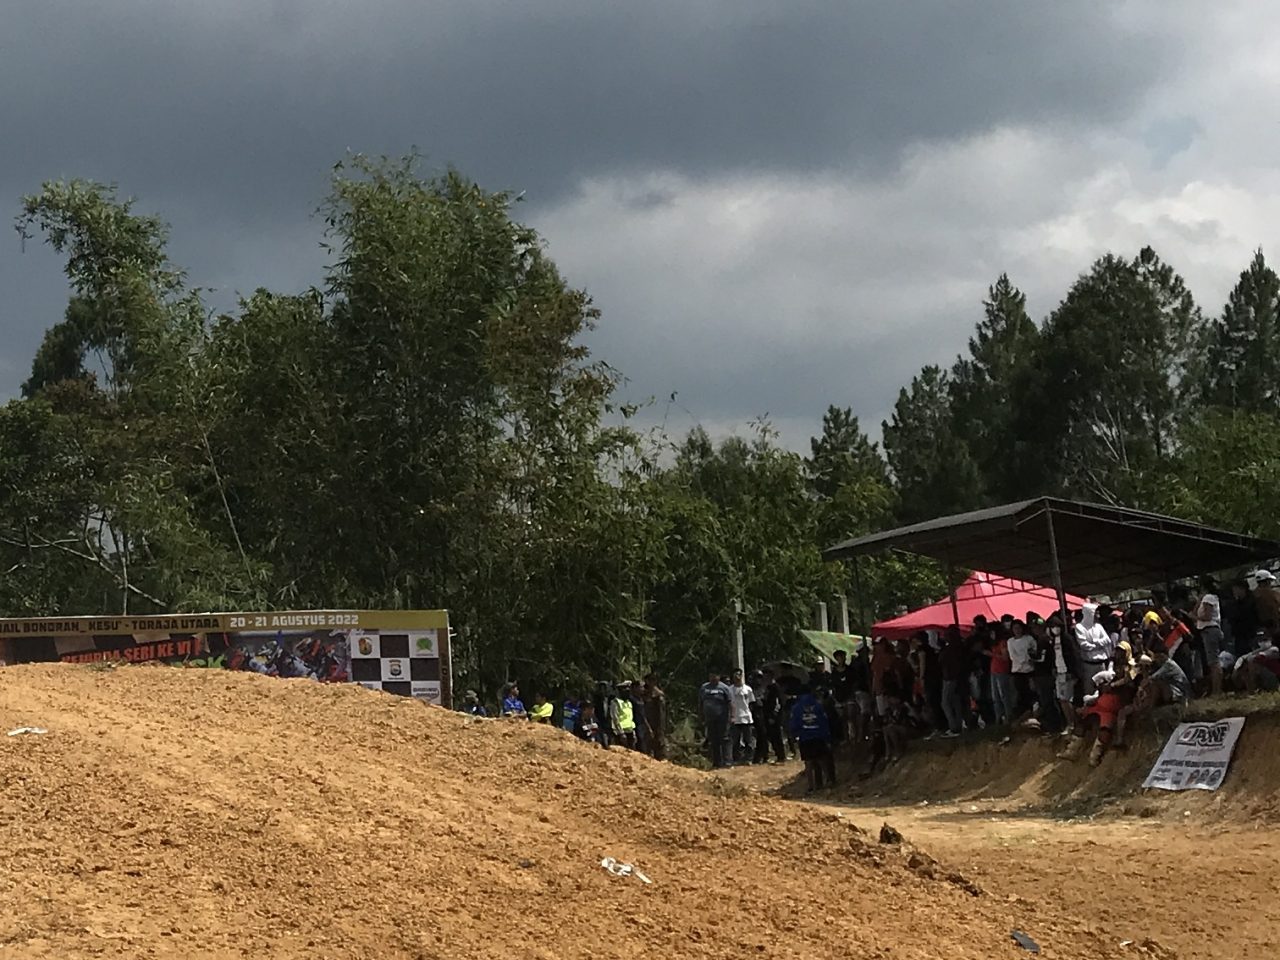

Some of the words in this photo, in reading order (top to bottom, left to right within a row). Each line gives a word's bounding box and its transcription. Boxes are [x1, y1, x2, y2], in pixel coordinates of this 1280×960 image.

[131, 619, 179, 631] TORAJA
[181, 618, 220, 630] UTARA
[229, 616, 246, 628] 20
[254, 616, 267, 627] 21
[271, 615, 326, 627] AGUSTUS
[327, 614, 359, 626] 2022
[123, 643, 155, 662] SERI
[157, 642, 175, 658] KE
